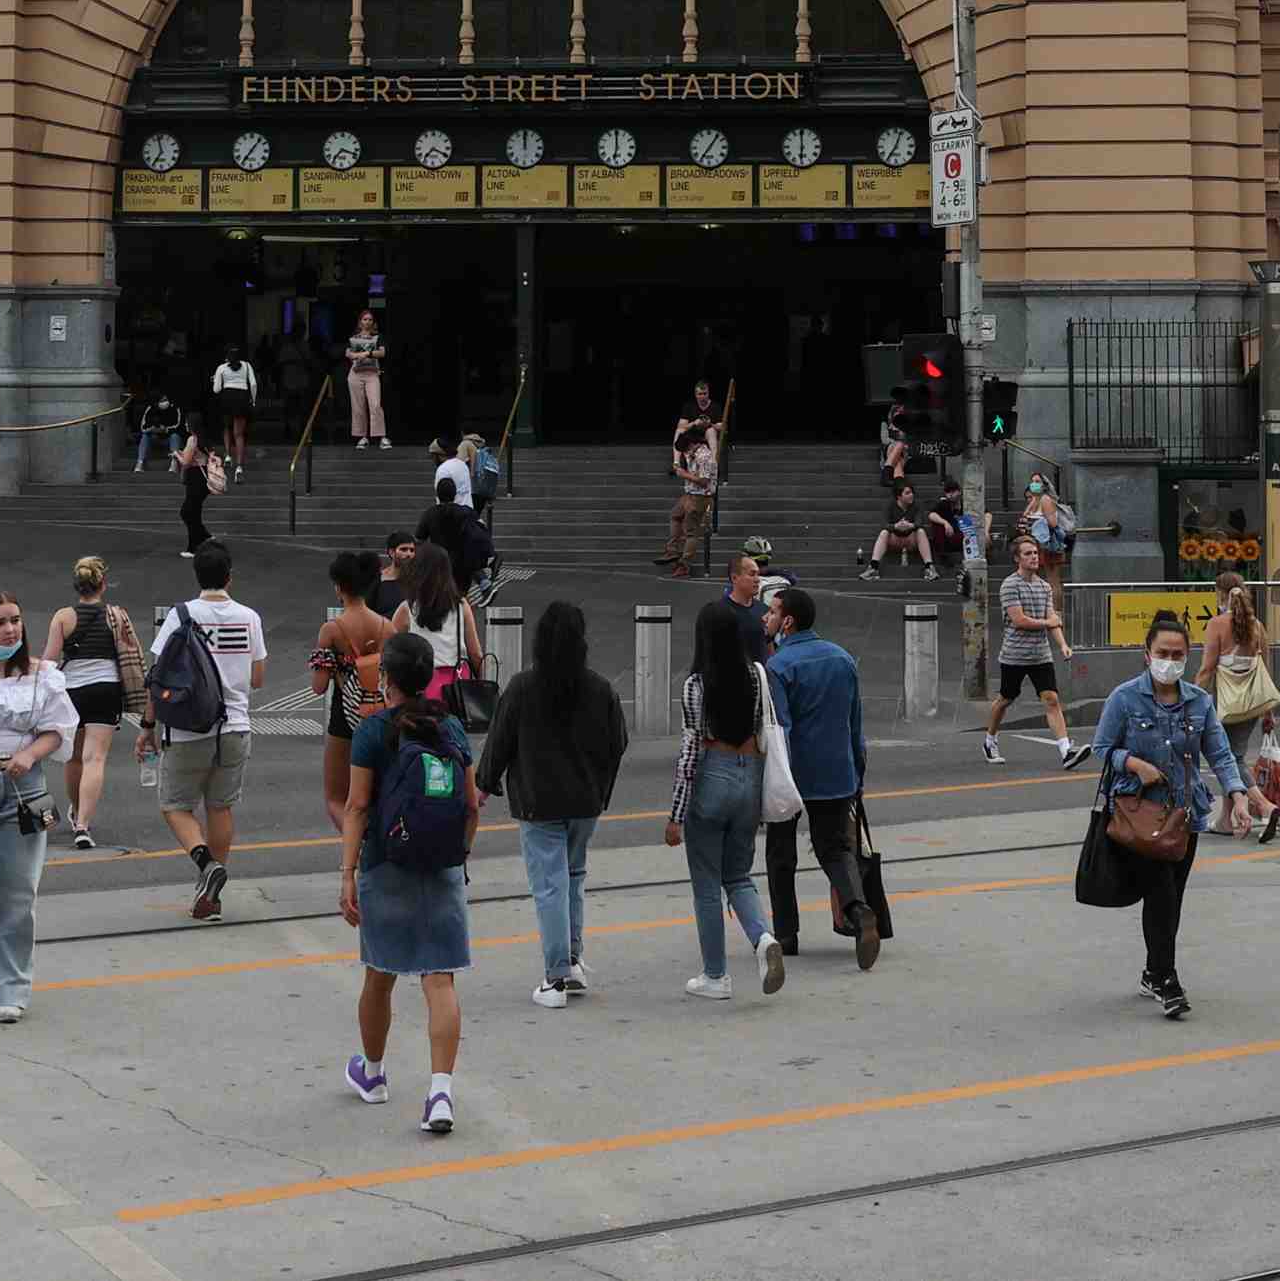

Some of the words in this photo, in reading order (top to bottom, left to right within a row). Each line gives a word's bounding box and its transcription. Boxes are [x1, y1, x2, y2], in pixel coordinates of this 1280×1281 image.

[242, 75, 413, 104] FLINDERS
[461, 74, 594, 102] STREET
[638, 72, 800, 101] STATION
[933, 139, 970, 153] CLEARWAY
[211, 172, 263, 183] FRANKSTON
[303, 171, 367, 182] SANDRINGHAM
[395, 170, 462, 180] WILLIAMSTOWN
[486, 168, 521, 178] ALTONA
[578, 169, 590, 179] ST
[592, 169, 625, 179] ALBANS
[763, 168, 800, 179] UPFIELD
[856, 167, 903, 178] WERRIBEE
[211, 184, 232, 194] LINE
[303, 183, 322, 194] LINE
[395, 182, 415, 192] LINE
[486, 181, 506, 191] LINE
[578, 181, 598, 191] LINE
[670, 181, 690, 191] LINE
[763, 180, 783, 191] LINE
[856, 180, 876, 190] LINE
[1271, 462, 1280, 472] A
